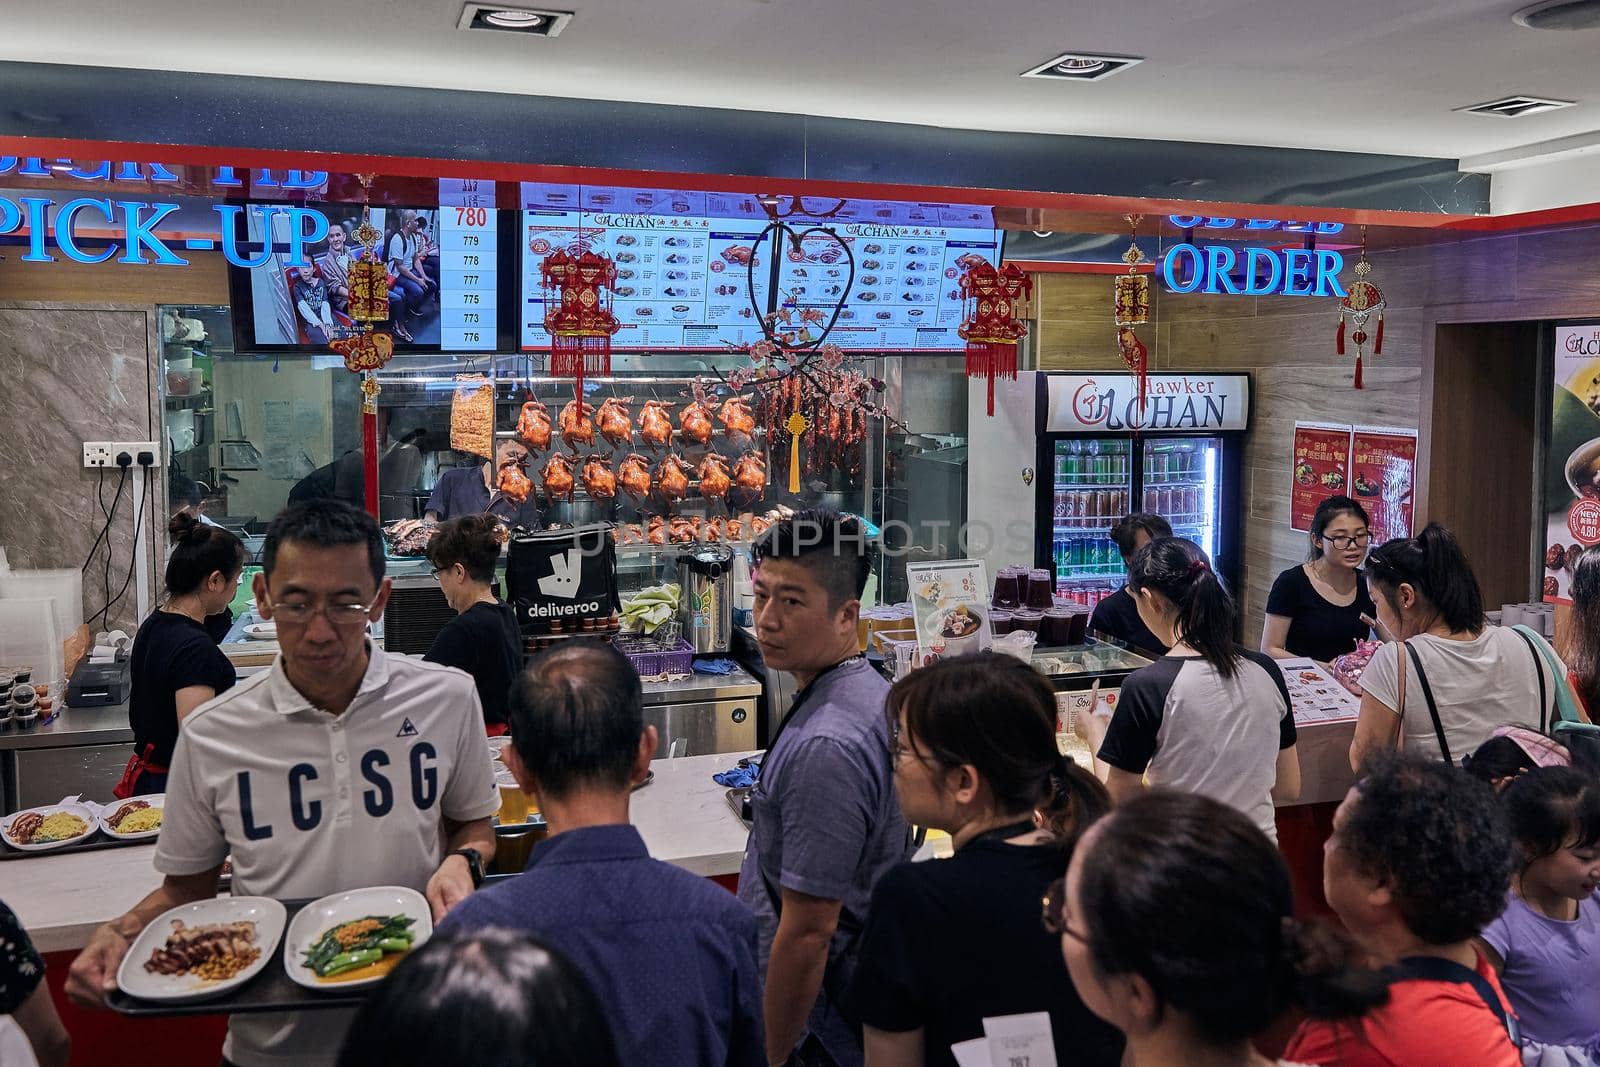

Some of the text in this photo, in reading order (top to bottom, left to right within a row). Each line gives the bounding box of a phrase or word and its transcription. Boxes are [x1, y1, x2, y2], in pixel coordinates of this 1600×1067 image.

[455, 207, 487, 227] 780
[614, 216, 656, 228] CHAN
[863, 226, 900, 238] CHAN
[463, 236, 480, 246] 779
[463, 255, 480, 266] 778
[1163, 242, 1348, 297] ORDER
[463, 275, 480, 285] 777
[463, 294, 480, 304] 775
[463, 313, 480, 323] 773
[463, 332, 480, 343] 776
[1125, 393, 1228, 430] CHAN
[1580, 510, 1599, 519] NEW
[527, 601, 599, 618] deliveroo
